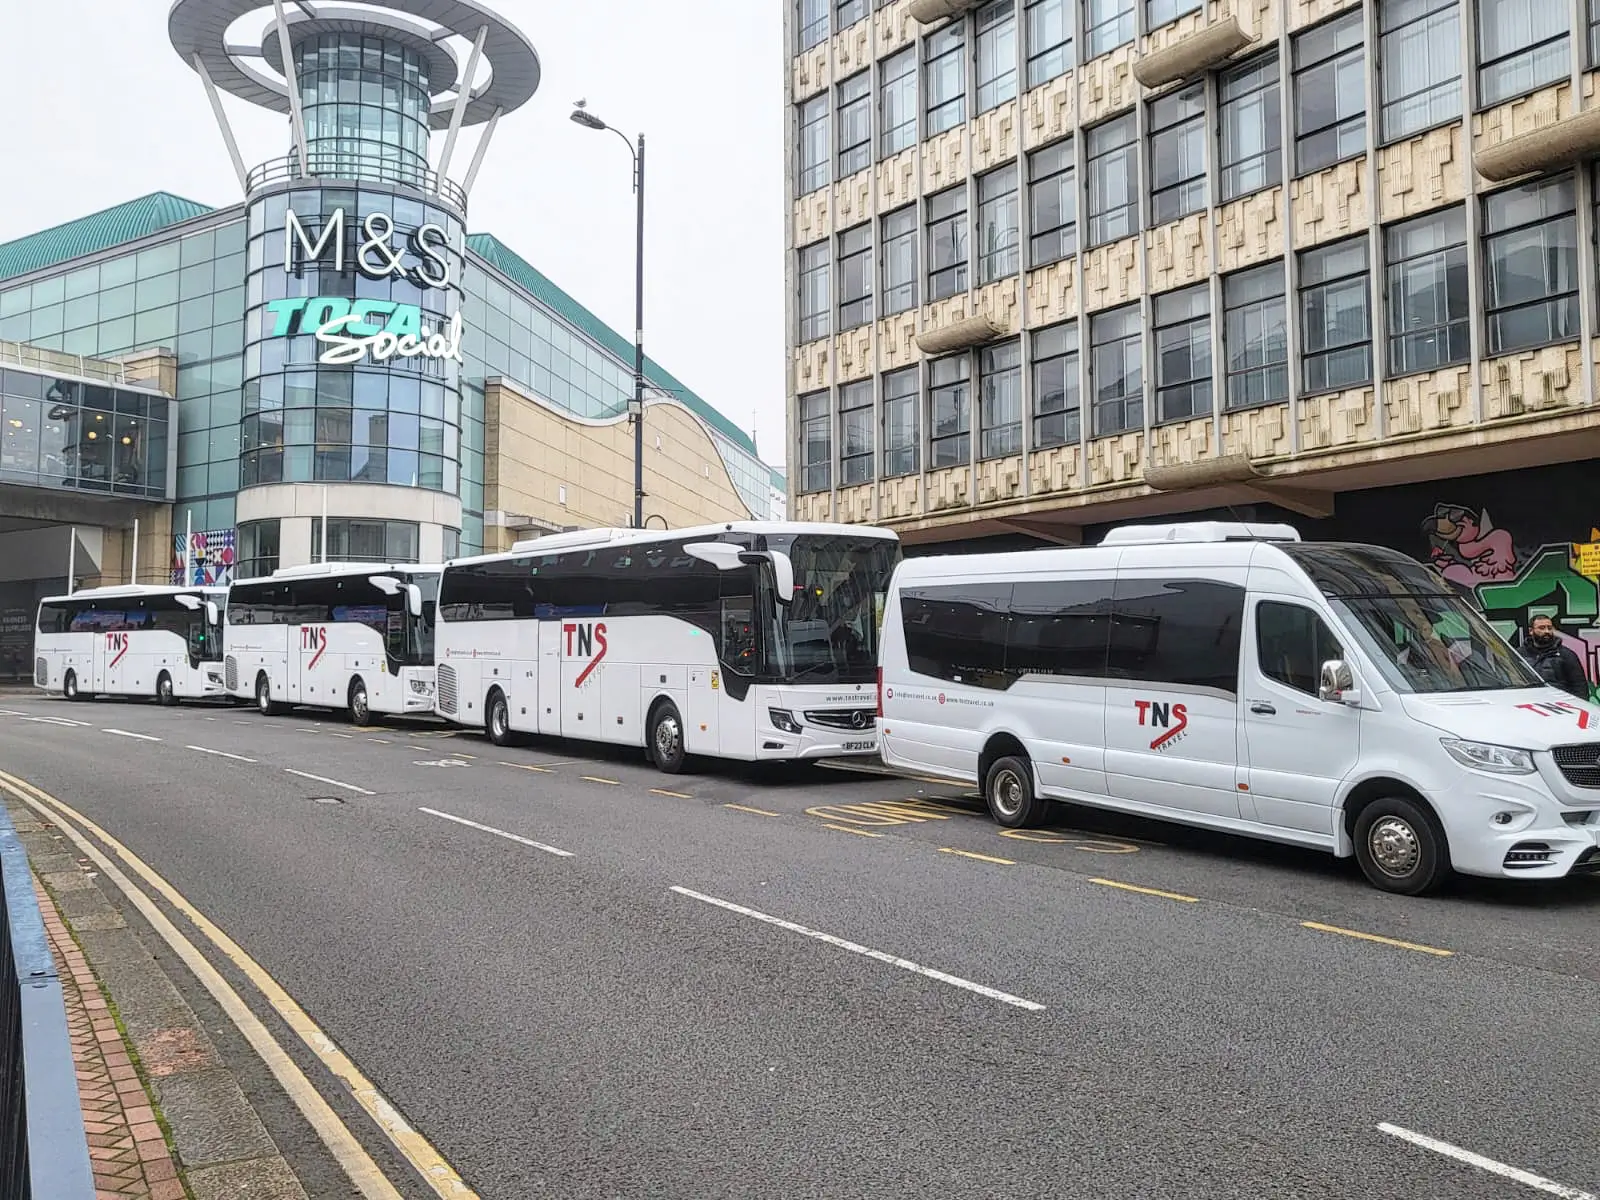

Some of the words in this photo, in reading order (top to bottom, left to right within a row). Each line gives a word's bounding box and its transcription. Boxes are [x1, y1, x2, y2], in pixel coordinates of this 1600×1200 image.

[284, 207, 450, 288] M&S
[268, 296, 421, 342] TOCA
[315, 311, 463, 365] Social
[106, 633, 128, 668] TNS
[301, 627, 327, 670] TNS
[563, 623, 608, 688] TNS
[826, 693, 877, 702] www.tnstravel.
[1513, 702, 1589, 729] TNS
[1135, 700, 1187, 750] TNS
[1157, 730, 1188, 753] TRAVEL
